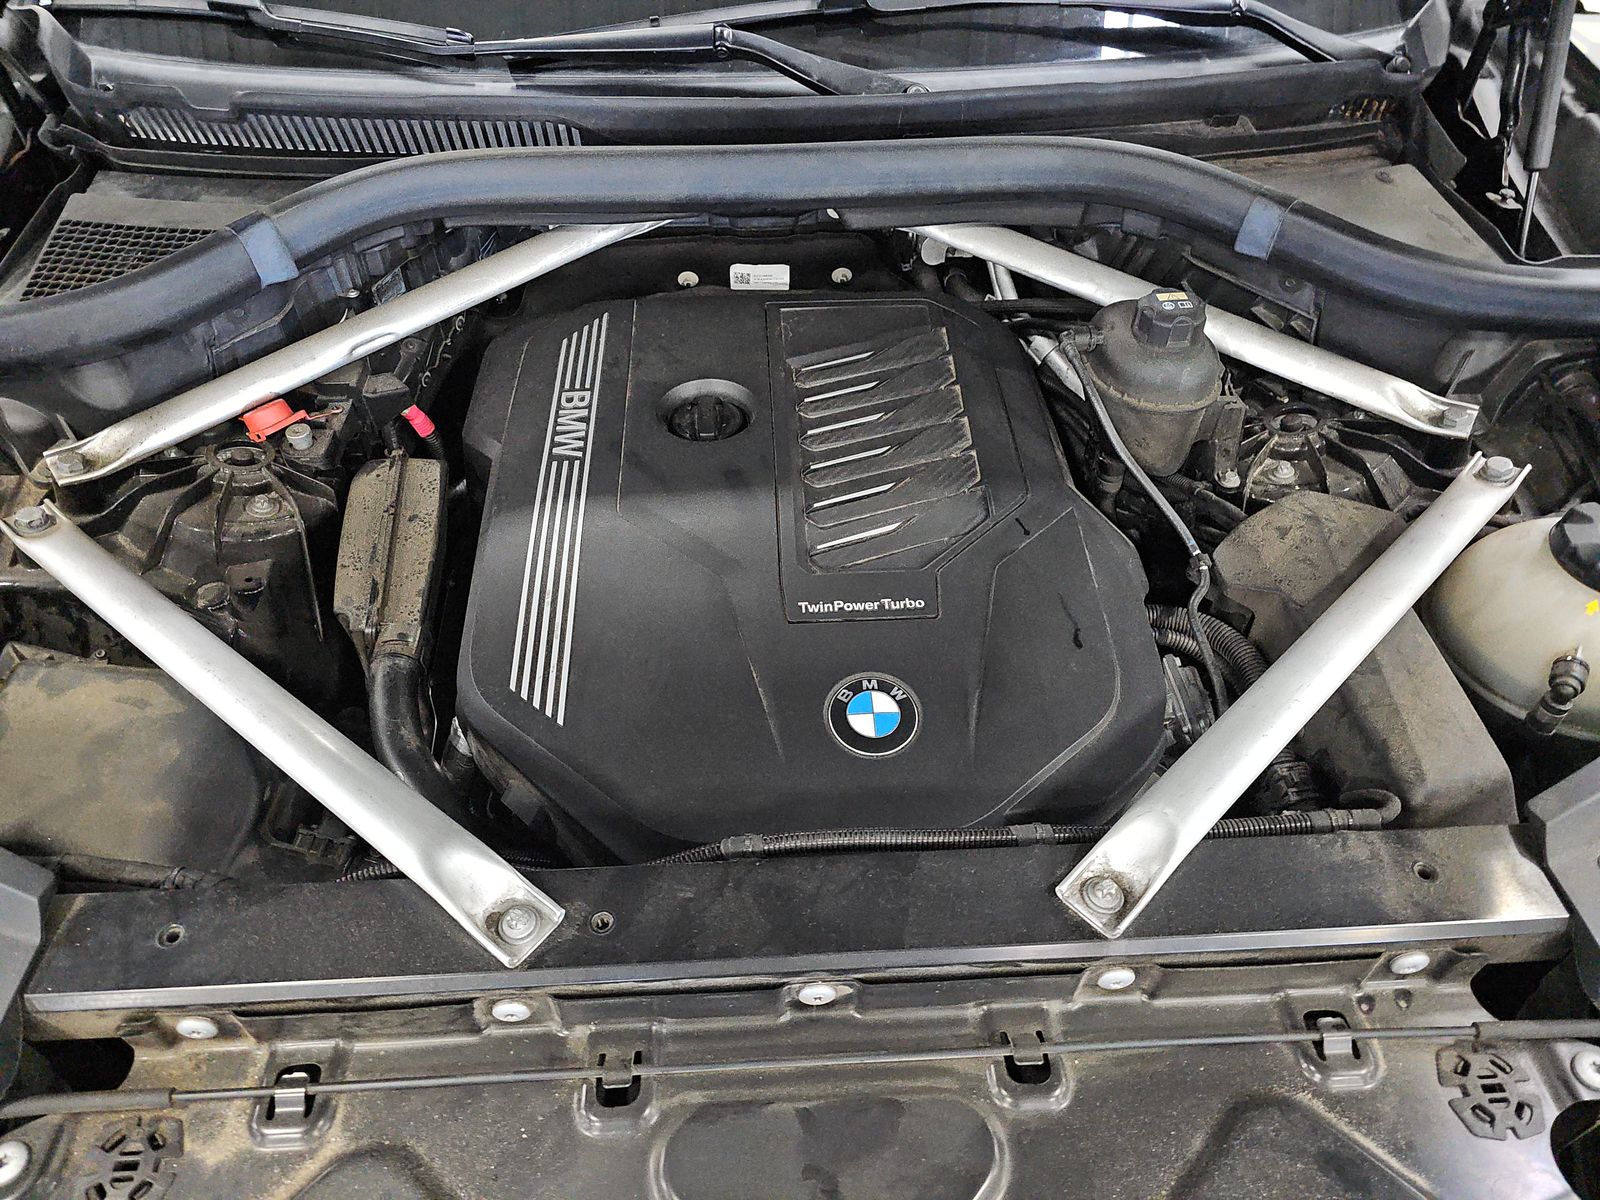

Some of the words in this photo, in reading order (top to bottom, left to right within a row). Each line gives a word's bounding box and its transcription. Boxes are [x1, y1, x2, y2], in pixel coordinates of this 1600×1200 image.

[552, 391, 591, 457] BMW
[798, 600, 880, 614] TwinPower
[881, 597, 926, 610] Turbo
[837, 679, 908, 703] BMW
